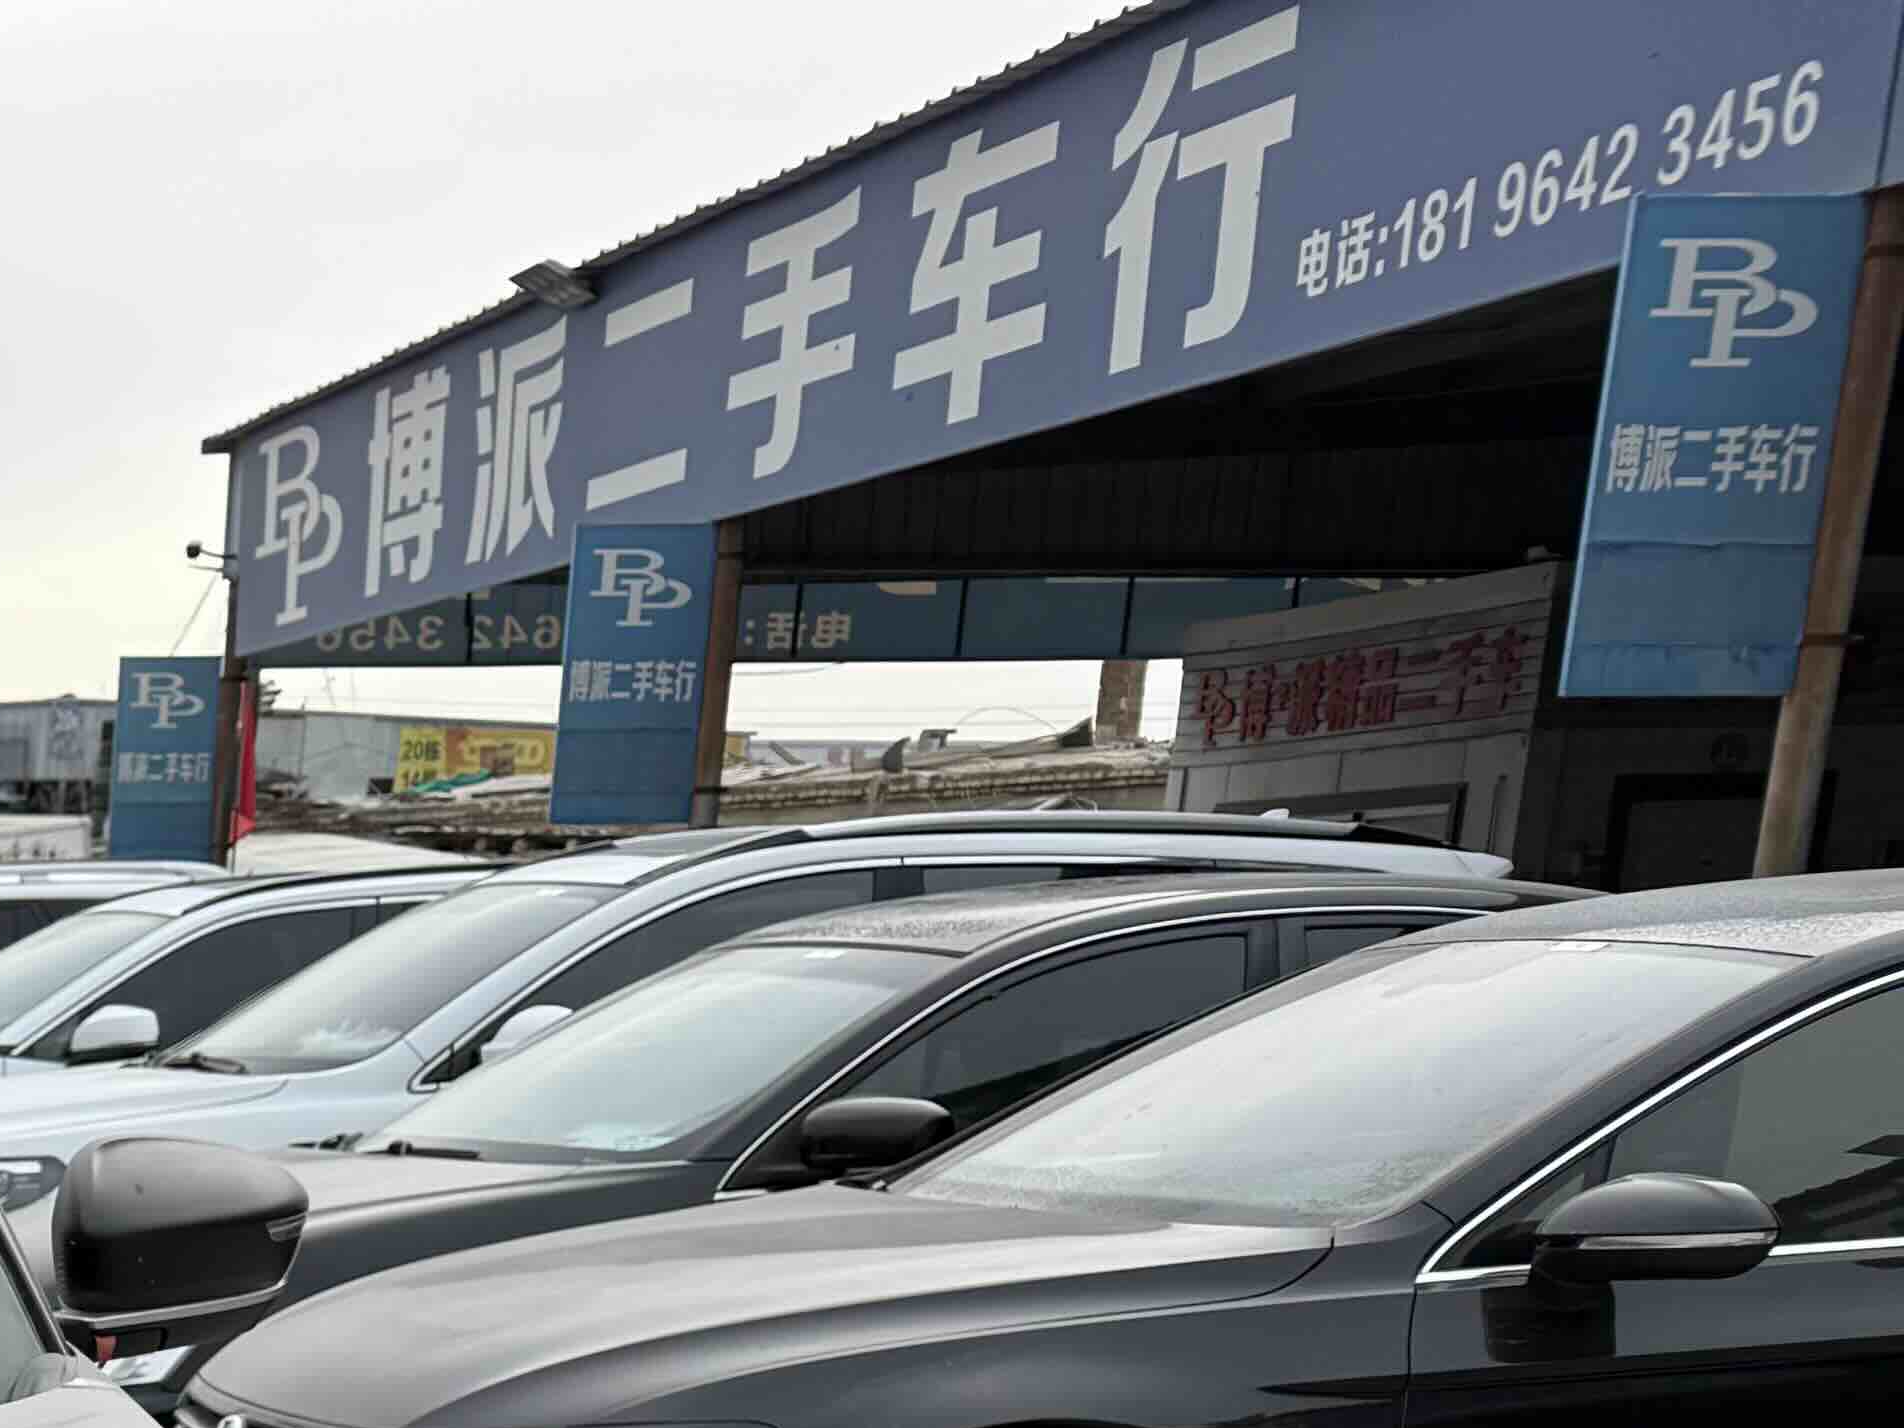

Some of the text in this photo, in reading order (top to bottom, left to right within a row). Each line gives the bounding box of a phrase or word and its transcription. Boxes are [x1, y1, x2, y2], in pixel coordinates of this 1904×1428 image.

[1493, 122, 1639, 238] 9642
[1656, 59, 1824, 185] 3456
[363, 4, 1300, 598] 博派二手车行
[1605, 423, 1818, 493] 博派二手车行
[569, 660, 697, 702] 博派二手车行
